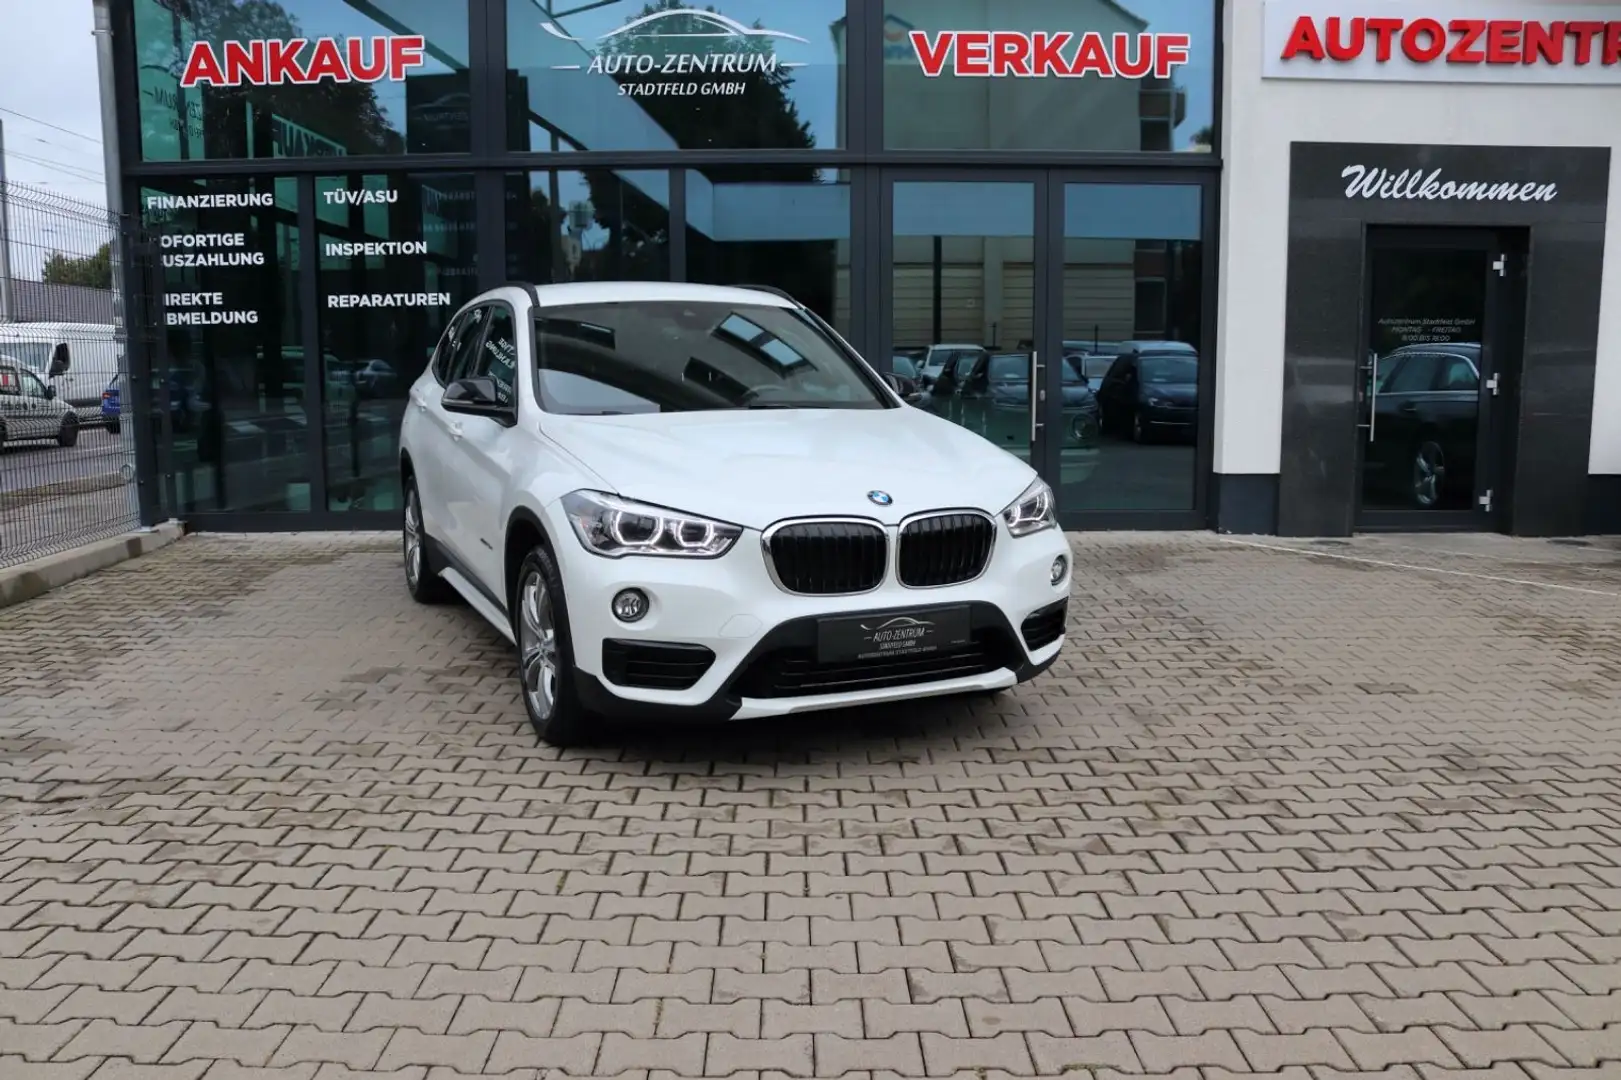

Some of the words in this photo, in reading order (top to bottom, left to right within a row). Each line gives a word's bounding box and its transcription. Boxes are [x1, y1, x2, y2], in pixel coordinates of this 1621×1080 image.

[180, 35, 424, 87] ANKAUF
[909, 31, 1190, 78] VERKAUF
[587, 53, 777, 75] AUTO-ZENTRUM
[617, 82, 697, 96] STADTFELD
[700, 82, 746, 95] GMBH
[1341, 164, 1557, 201] Willkommen
[147, 193, 274, 210] FINANZIERUNG
[324, 188, 398, 206] TÜV/ASU
[160, 233, 245, 248] OFORTIGE
[325, 240, 428, 257] INSPEKTION
[161, 252, 265, 268] USZAHLUNG
[163, 292, 223, 306] IREKTE
[327, 291, 451, 309] REPARATUREN
[165, 311, 259, 326] BMELDUNG
